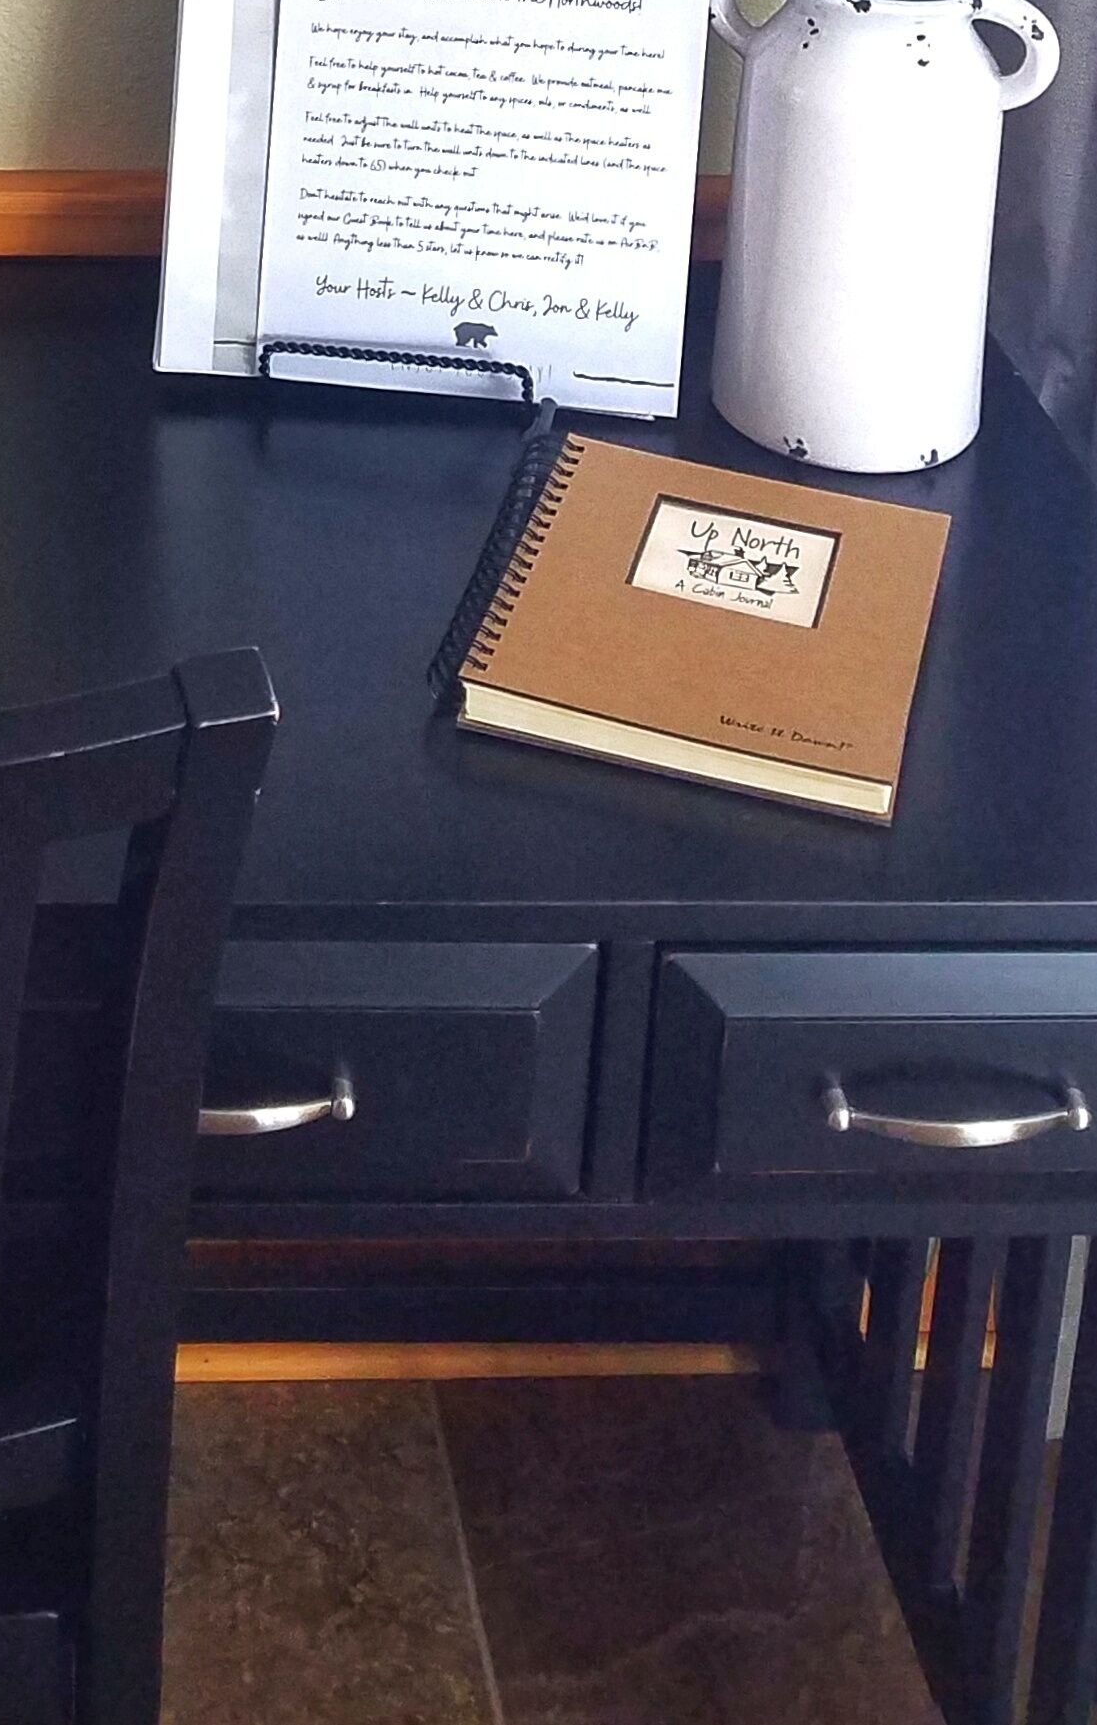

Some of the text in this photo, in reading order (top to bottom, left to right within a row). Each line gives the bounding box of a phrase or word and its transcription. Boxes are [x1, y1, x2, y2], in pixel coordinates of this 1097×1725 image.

[316, 274, 639, 332] Your Hosts Kelly & Chris, Jon & Kelly
[691, 521, 800, 559] Up North
[675, 579, 774, 609] A Cabin Journal
